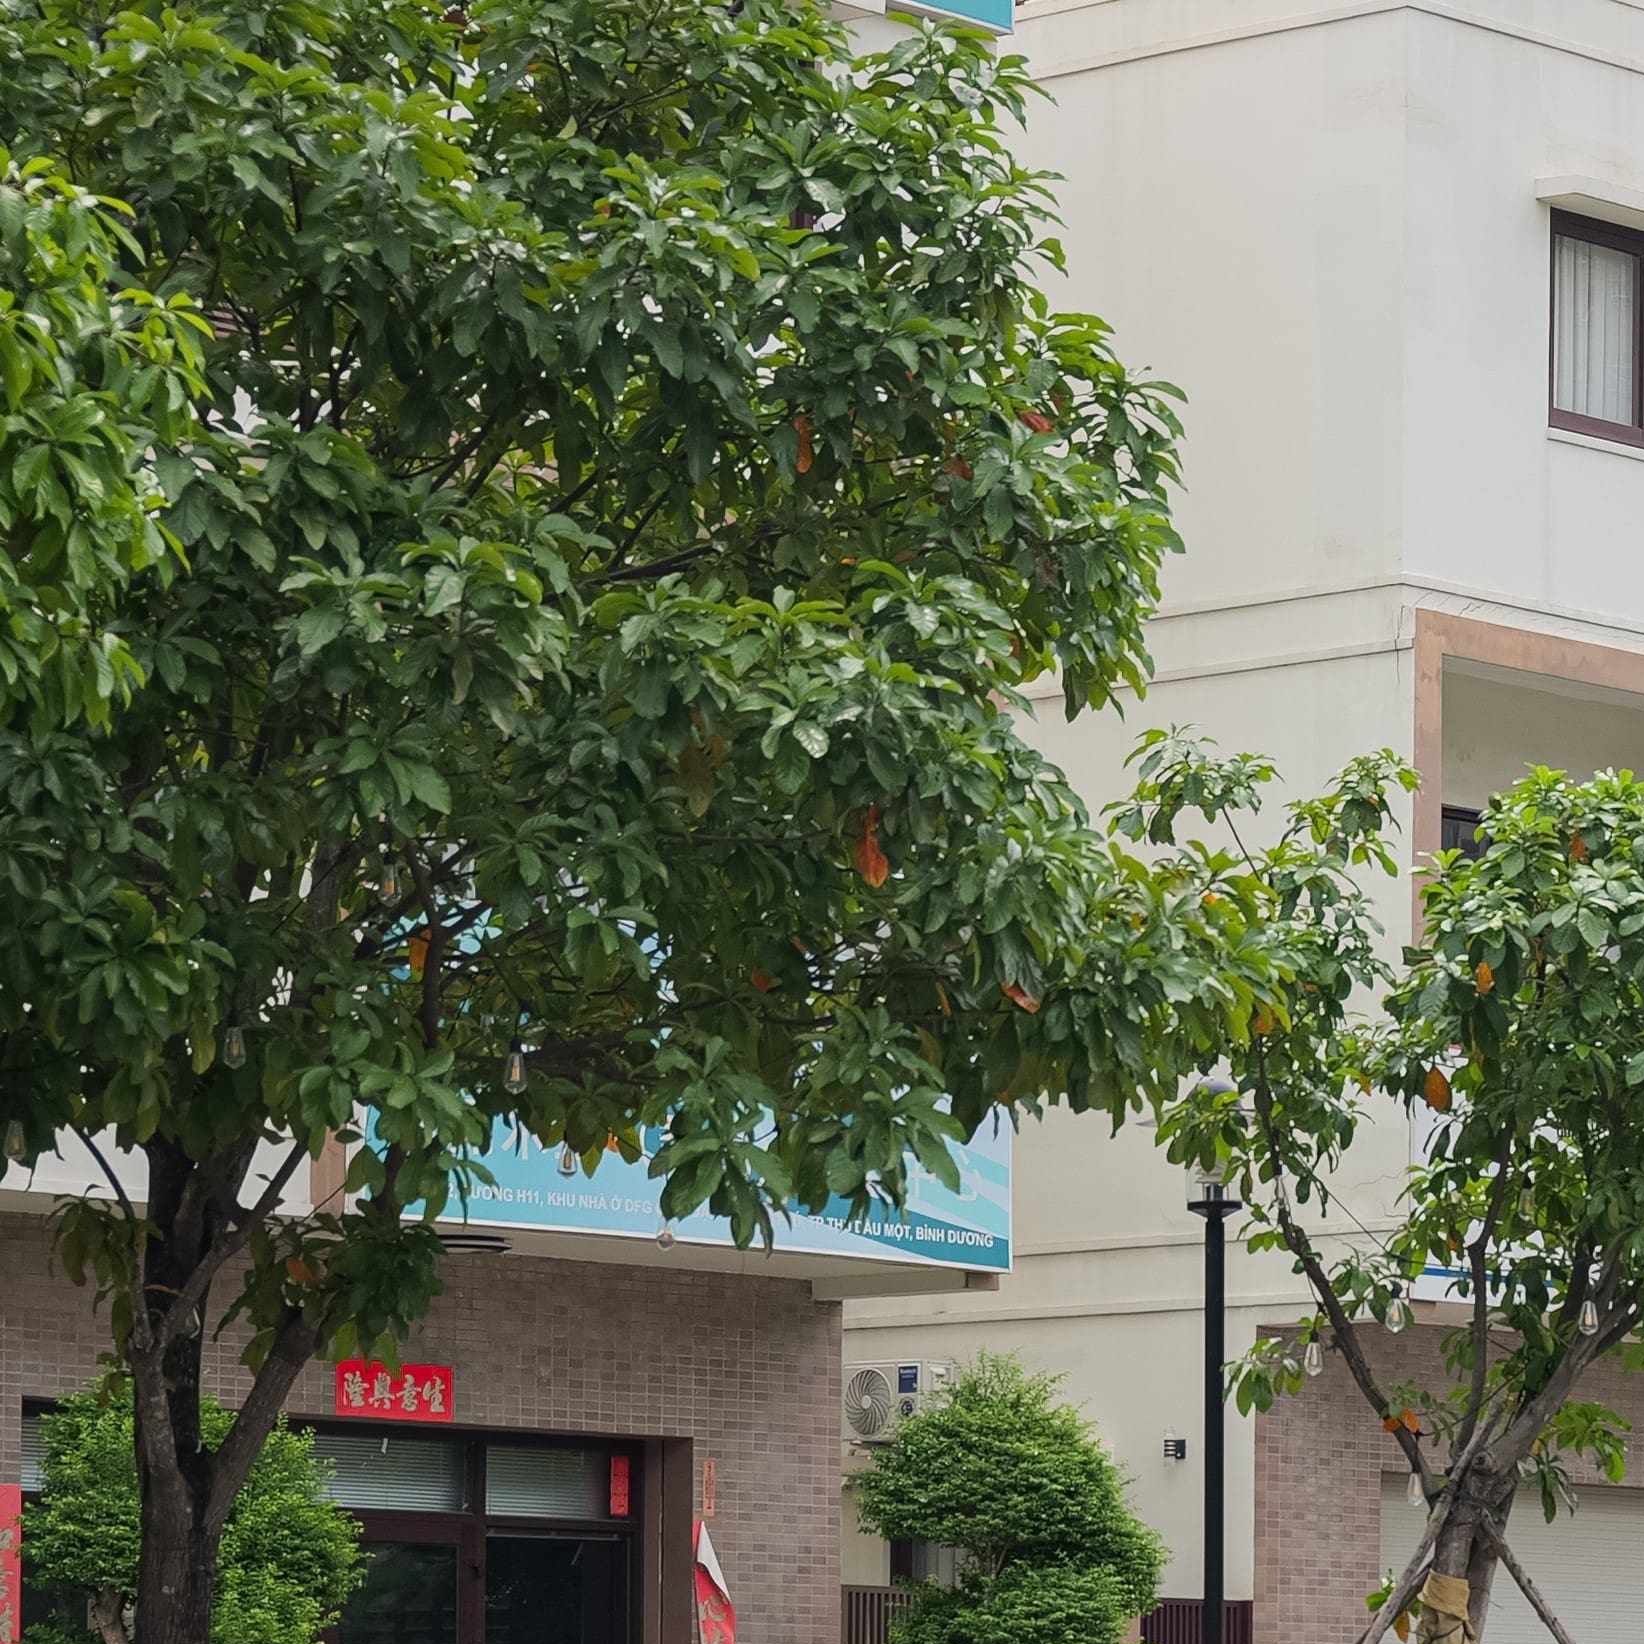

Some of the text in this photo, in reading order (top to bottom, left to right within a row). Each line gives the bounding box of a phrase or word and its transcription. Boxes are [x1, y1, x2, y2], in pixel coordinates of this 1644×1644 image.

[516, 1189, 545, 1207] H11,
[547, 1191, 576, 1208] KHU
[625, 1198, 651, 1214] DFG
[916, 1223, 946, 1244] BÌNH
[947, 1230, 994, 1248] DƯƠNG
